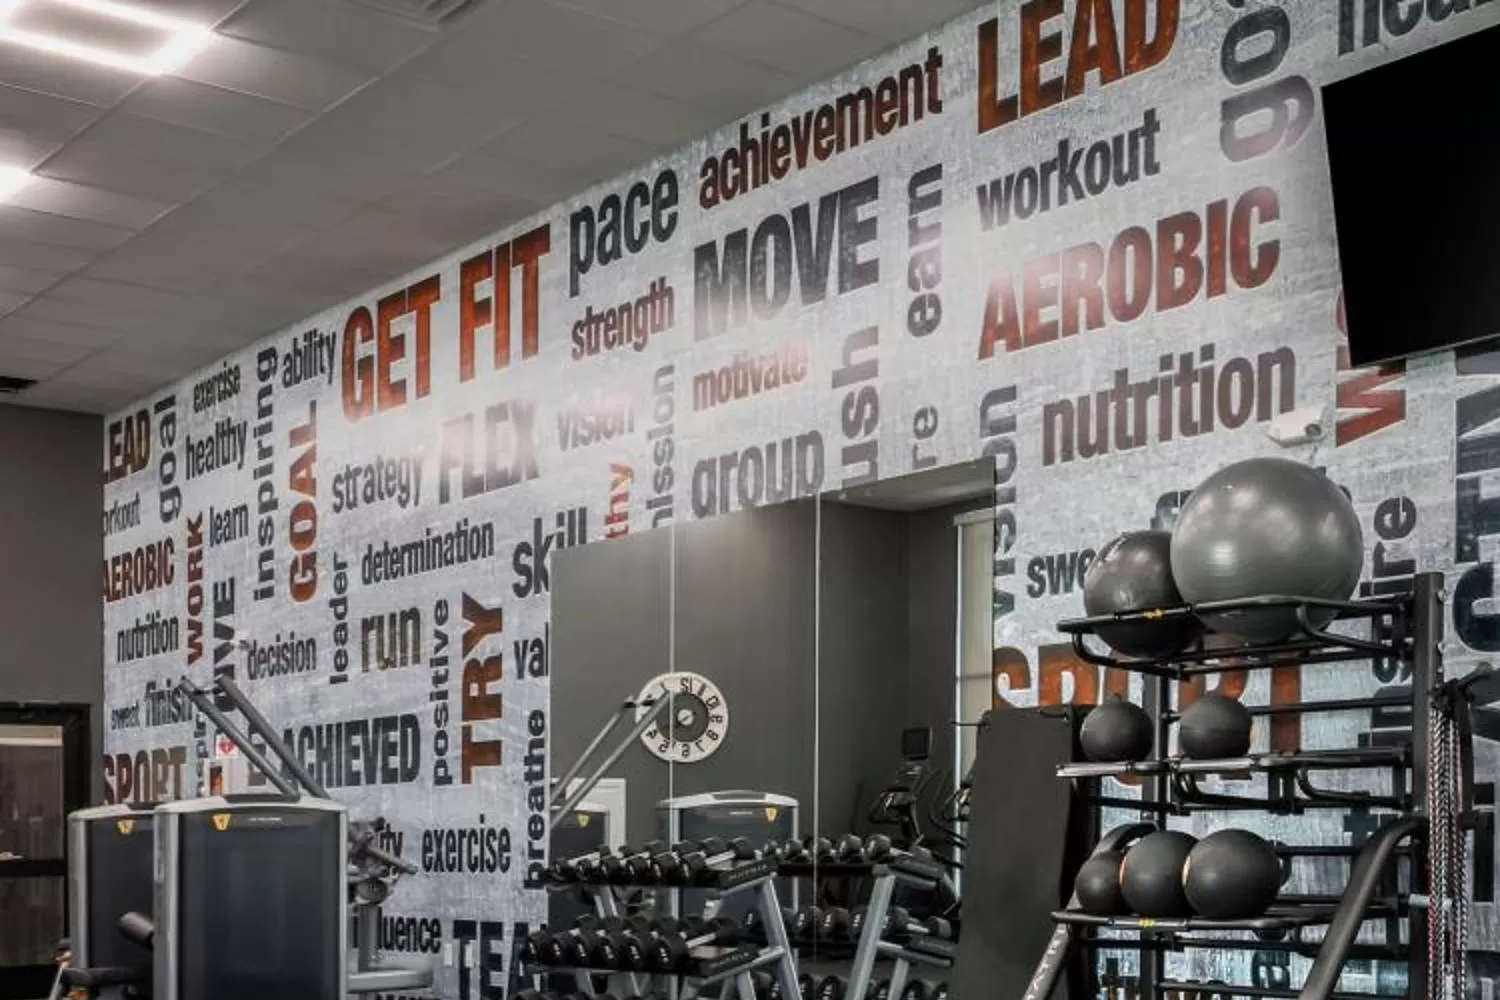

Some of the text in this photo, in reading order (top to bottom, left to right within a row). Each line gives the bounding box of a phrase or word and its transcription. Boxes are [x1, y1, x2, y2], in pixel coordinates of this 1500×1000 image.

[701, 46, 943, 209] achievement
[977, 0, 1182, 134] LEAD
[1221, 0, 1315, 163] go
[976, 108, 1160, 231] workout
[569, 169, 678, 297] pace
[694, 175, 879, 341] MOVE
[907, 163, 943, 338] earn
[978, 186, 1280, 360] AEROBIC
[282, 330, 337, 388] ability
[341, 223, 550, 423] GET FIT
[571, 276, 674, 360] strength
[693, 344, 808, 411] motivate
[185, 416, 248, 480] healthy
[193, 361, 241, 413] exercise
[556, 398, 635, 451] vision
[1042, 343, 1296, 467] nutrition
[154, 396, 182, 524] goal
[253, 346, 278, 601] inspiring
[289, 400, 319, 602] GOAL
[332, 455, 424, 514] strategy
[438, 400, 541, 505] FLEX
[104, 536, 175, 603] AEROBIC
[209, 503, 249, 547] learn
[361, 517, 495, 587] determination
[117, 610, 178, 663] nutrition
[187, 511, 204, 665] WORK
[329, 552, 349, 685] leader
[361, 606, 422, 673] run
[247, 630, 317, 681] decision
[430, 599, 452, 786] positive
[462, 591, 503, 784] TRY
[421, 814, 511, 873] exercise
[524, 709, 548, 890] breathe
